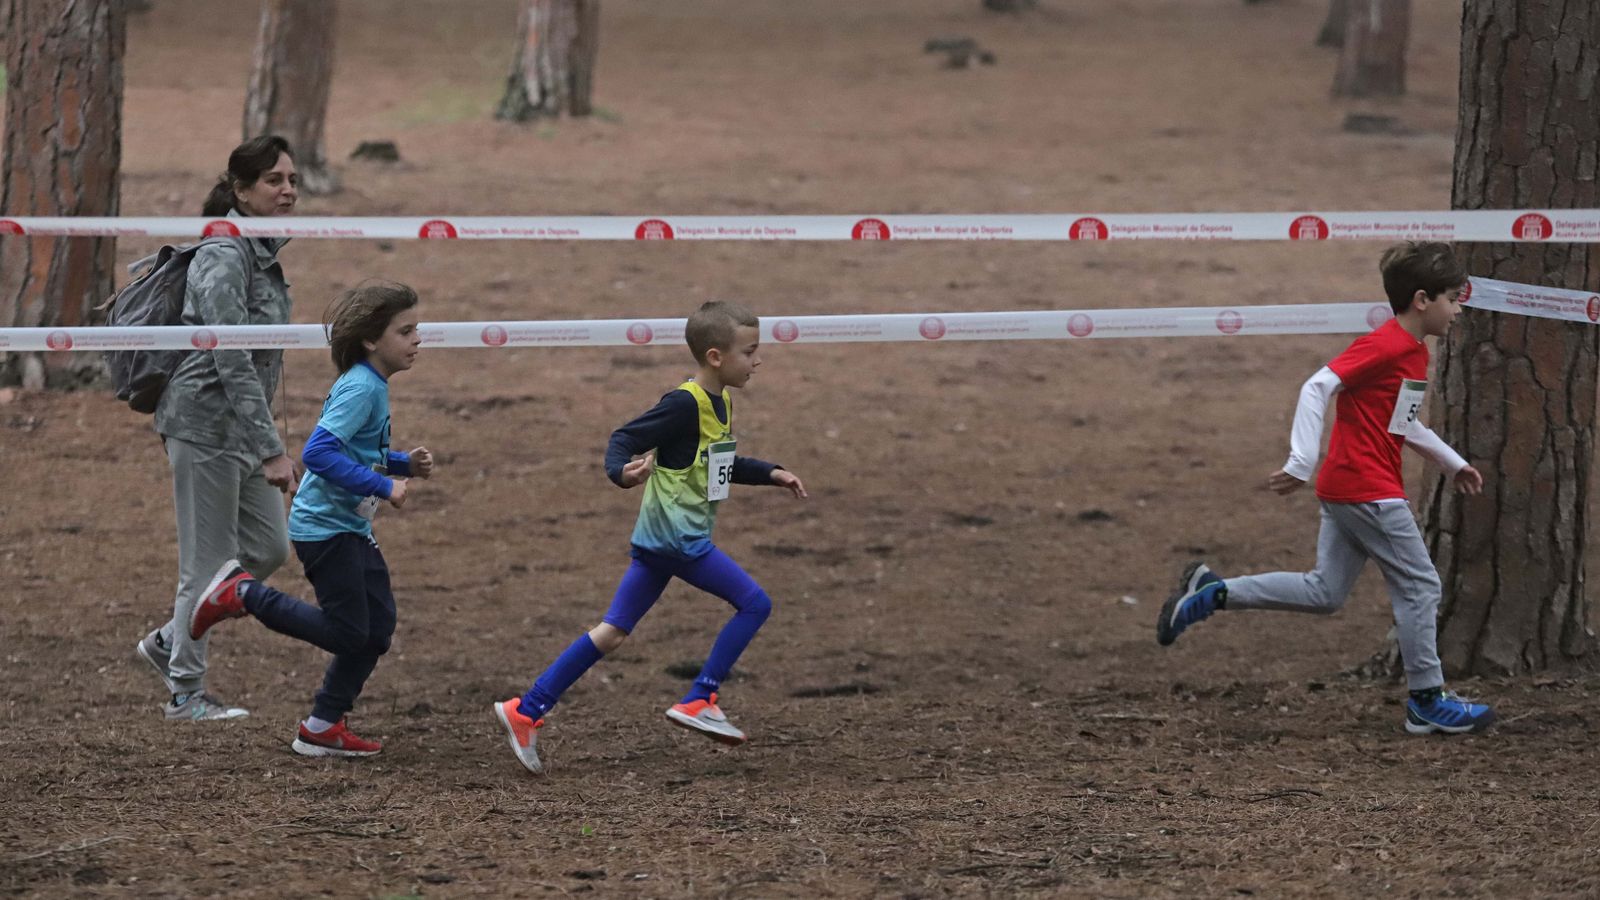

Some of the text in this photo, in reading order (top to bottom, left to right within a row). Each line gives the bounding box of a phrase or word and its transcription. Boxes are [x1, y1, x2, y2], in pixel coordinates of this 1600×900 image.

[537, 227, 545, 236] de
[547, 227, 579, 236] Deportes
[717, 226, 751, 236] Municipal
[753, 226, 761, 236] de
[763, 226, 796, 235] Deportes
[934, 225, 968, 234] Municipal
[970, 225, 978, 234] de
[980, 225, 1013, 234] Deportes
[1152, 224, 1187, 233] Municipal
[1189, 224, 1198, 233] de
[1199, 224, 1233, 233] Deportes
[1373, 223, 1409, 232] Municipal
[1410, 223, 1420, 232] de
[1421, 223, 1455, 232] Deportes
